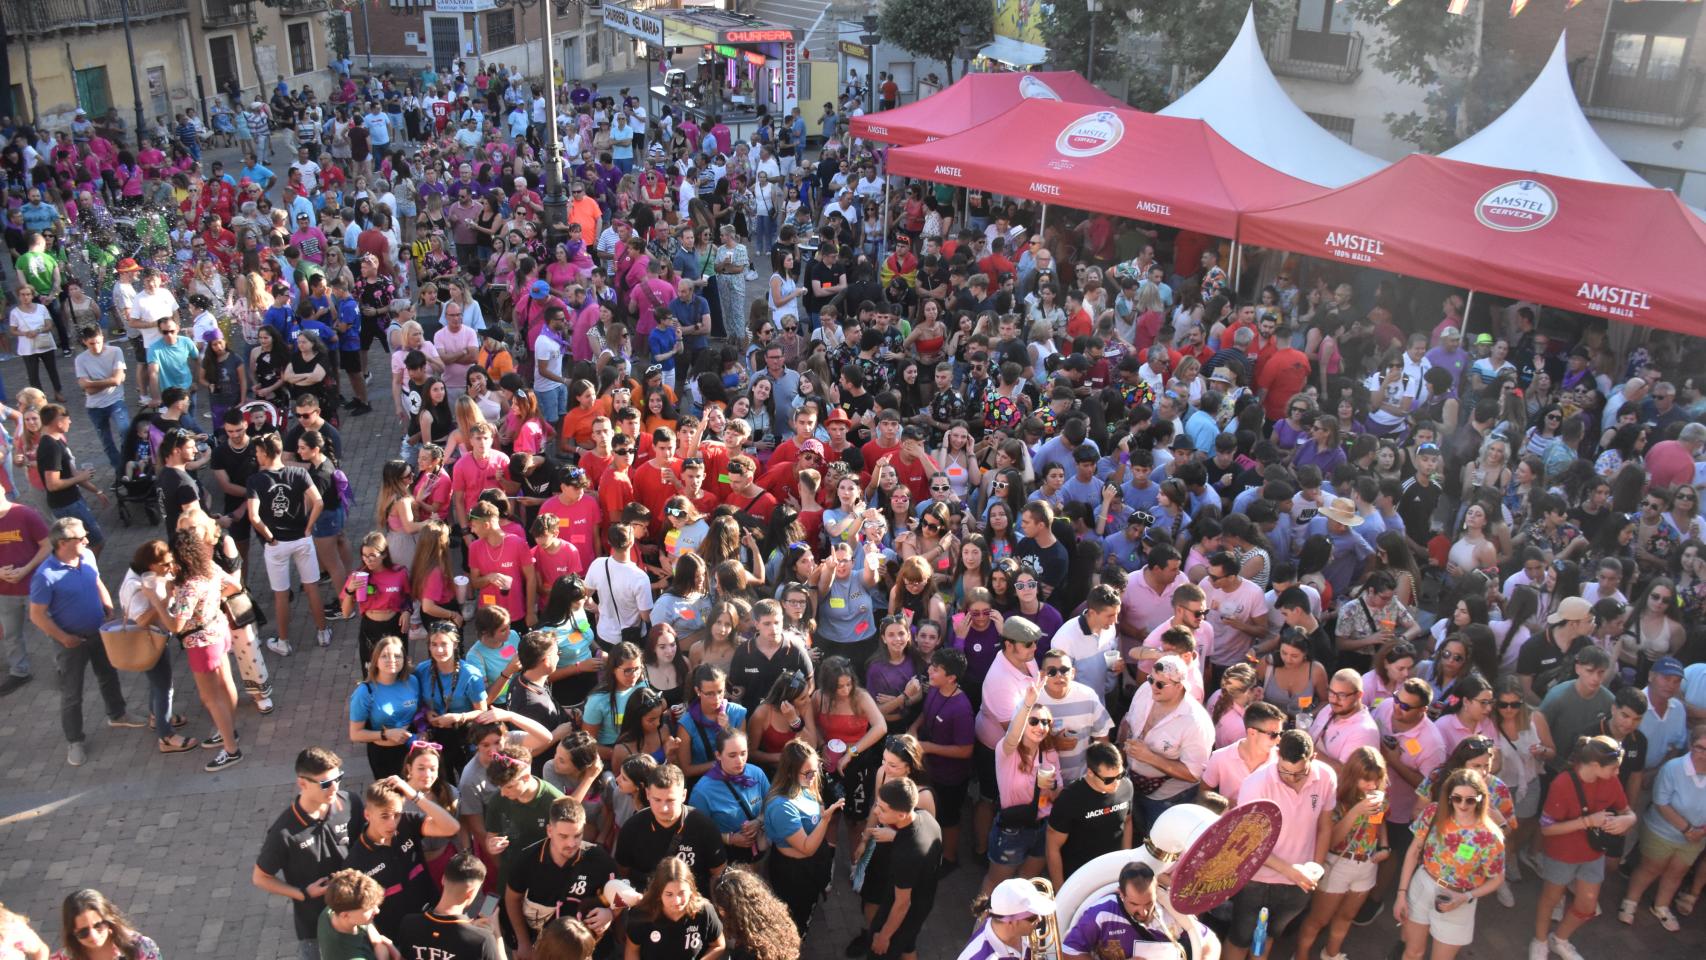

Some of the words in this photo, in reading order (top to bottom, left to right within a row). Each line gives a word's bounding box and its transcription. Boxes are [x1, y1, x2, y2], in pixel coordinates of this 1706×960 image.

[726, 31, 793, 41] CHURRERIA
[434, 107, 446, 116] 20
[867, 125, 889, 136] AMSTEL
[1076, 128, 1107, 138] AMSTEL
[934, 165, 962, 177] AMSTEL
[1029, 182, 1060, 196] AMSTEL
[1136, 200, 1171, 216] AMSTEL
[1490, 196, 1544, 212] AMSTEL
[1489, 208, 1533, 220] CERVEZA
[1325, 231, 1384, 256] AMSTEL
[1351, 252, 1371, 262] MALTA
[1576, 282, 1651, 310] AMSTEL
[1609, 306, 1634, 318] MALTA
[1085, 808, 1104, 819] JACK
[684, 932, 701, 950] 18
